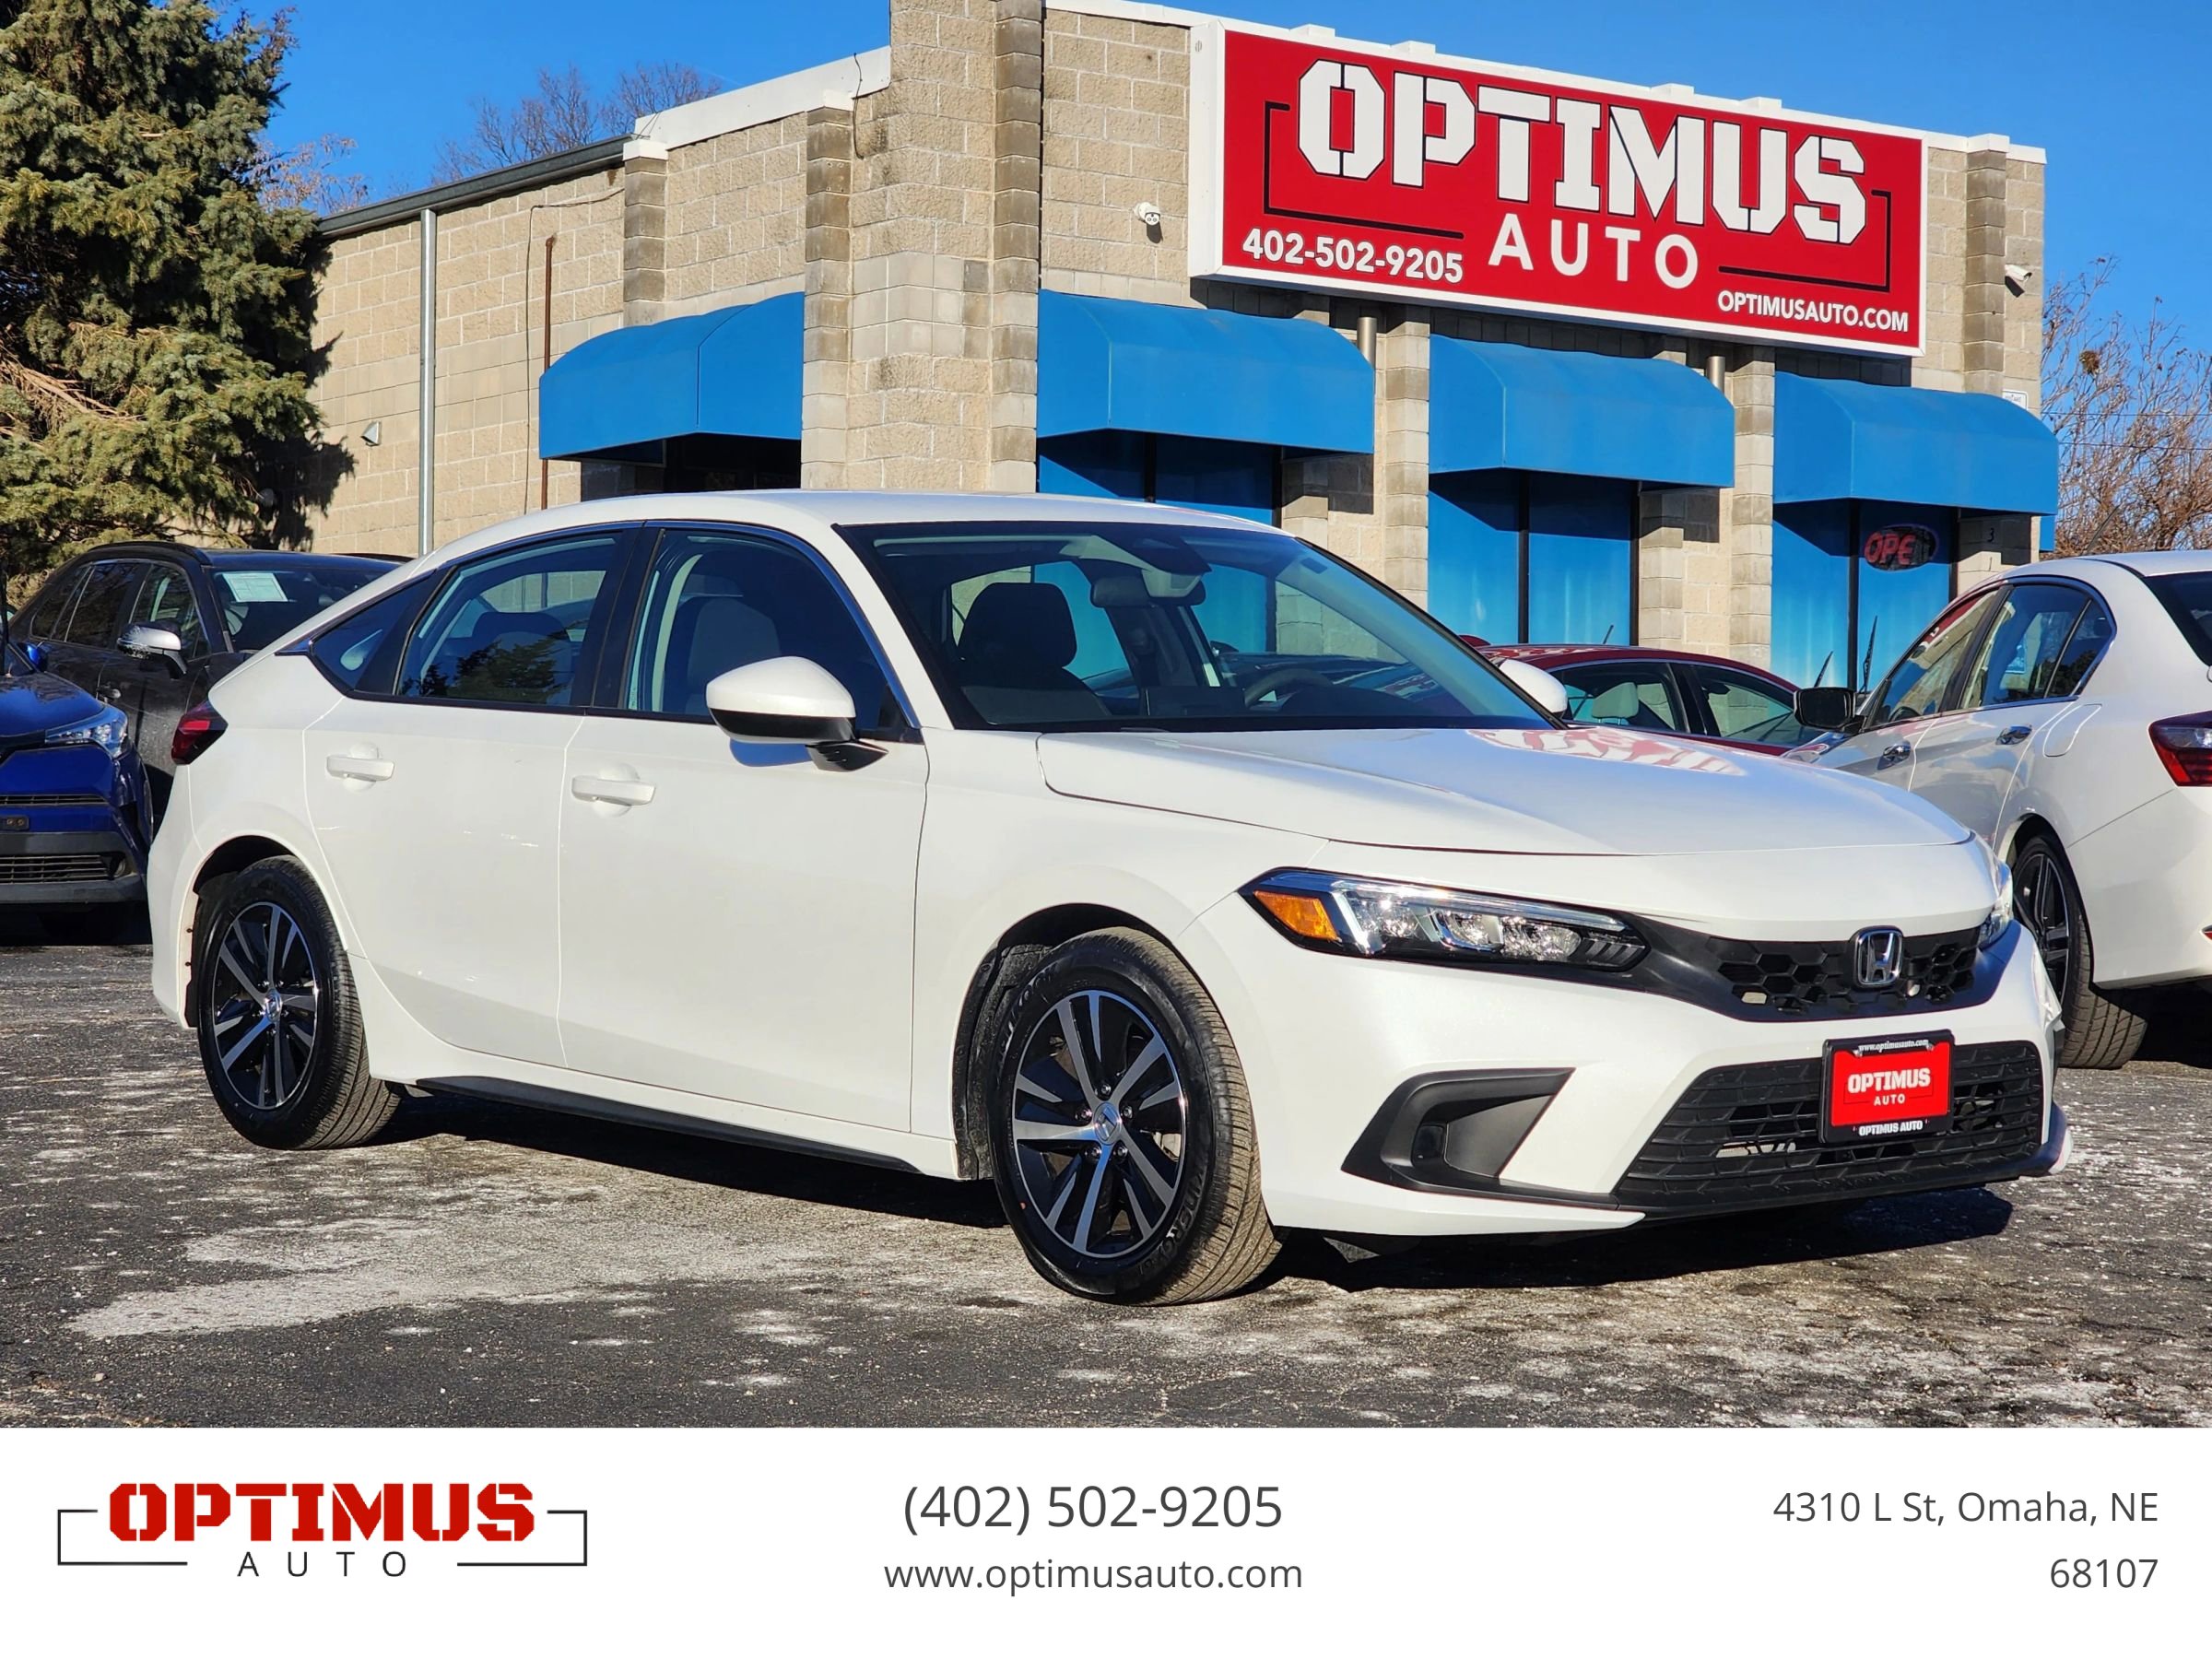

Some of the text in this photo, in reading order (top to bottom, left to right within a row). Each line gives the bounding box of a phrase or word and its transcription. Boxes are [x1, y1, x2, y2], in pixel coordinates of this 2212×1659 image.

[1298, 59, 1866, 244] OPTIMUS
[1241, 228, 1464, 284] 402-502-9205
[1488, 213, 1699, 289] AUTO
[1716, 289, 1910, 333] OPTIMUSAUTO.COM
[1858, 1040, 1929, 1053] www.optimusauto.com
[1848, 1068, 1930, 1093] OPTIMUS
[1874, 1095, 1905, 1106] AUTO
[1859, 1121, 1923, 1135] OPTIMUS AUTO
